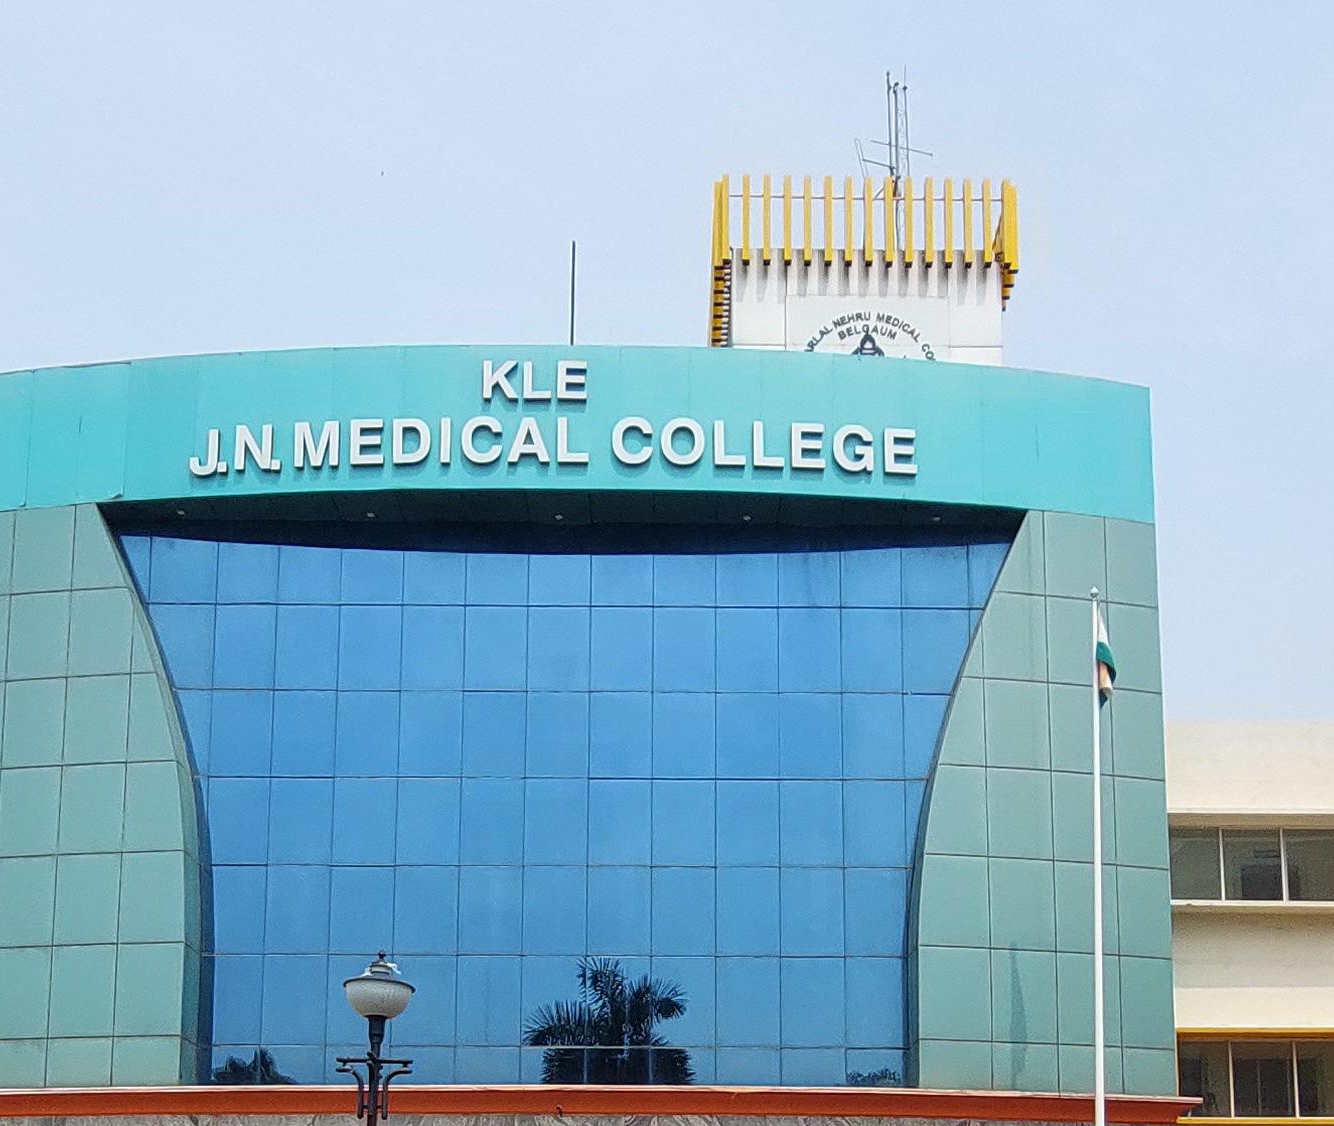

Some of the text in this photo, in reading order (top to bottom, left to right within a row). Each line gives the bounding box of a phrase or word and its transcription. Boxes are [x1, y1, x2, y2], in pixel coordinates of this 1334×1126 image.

[832, 311, 871, 329] NEHRU
[876, 312, 921, 342] MEDICAL
[921, 343, 936, 361] CO
[482, 360, 588, 400] KLE
[611, 416, 918, 475] COLLEGE
